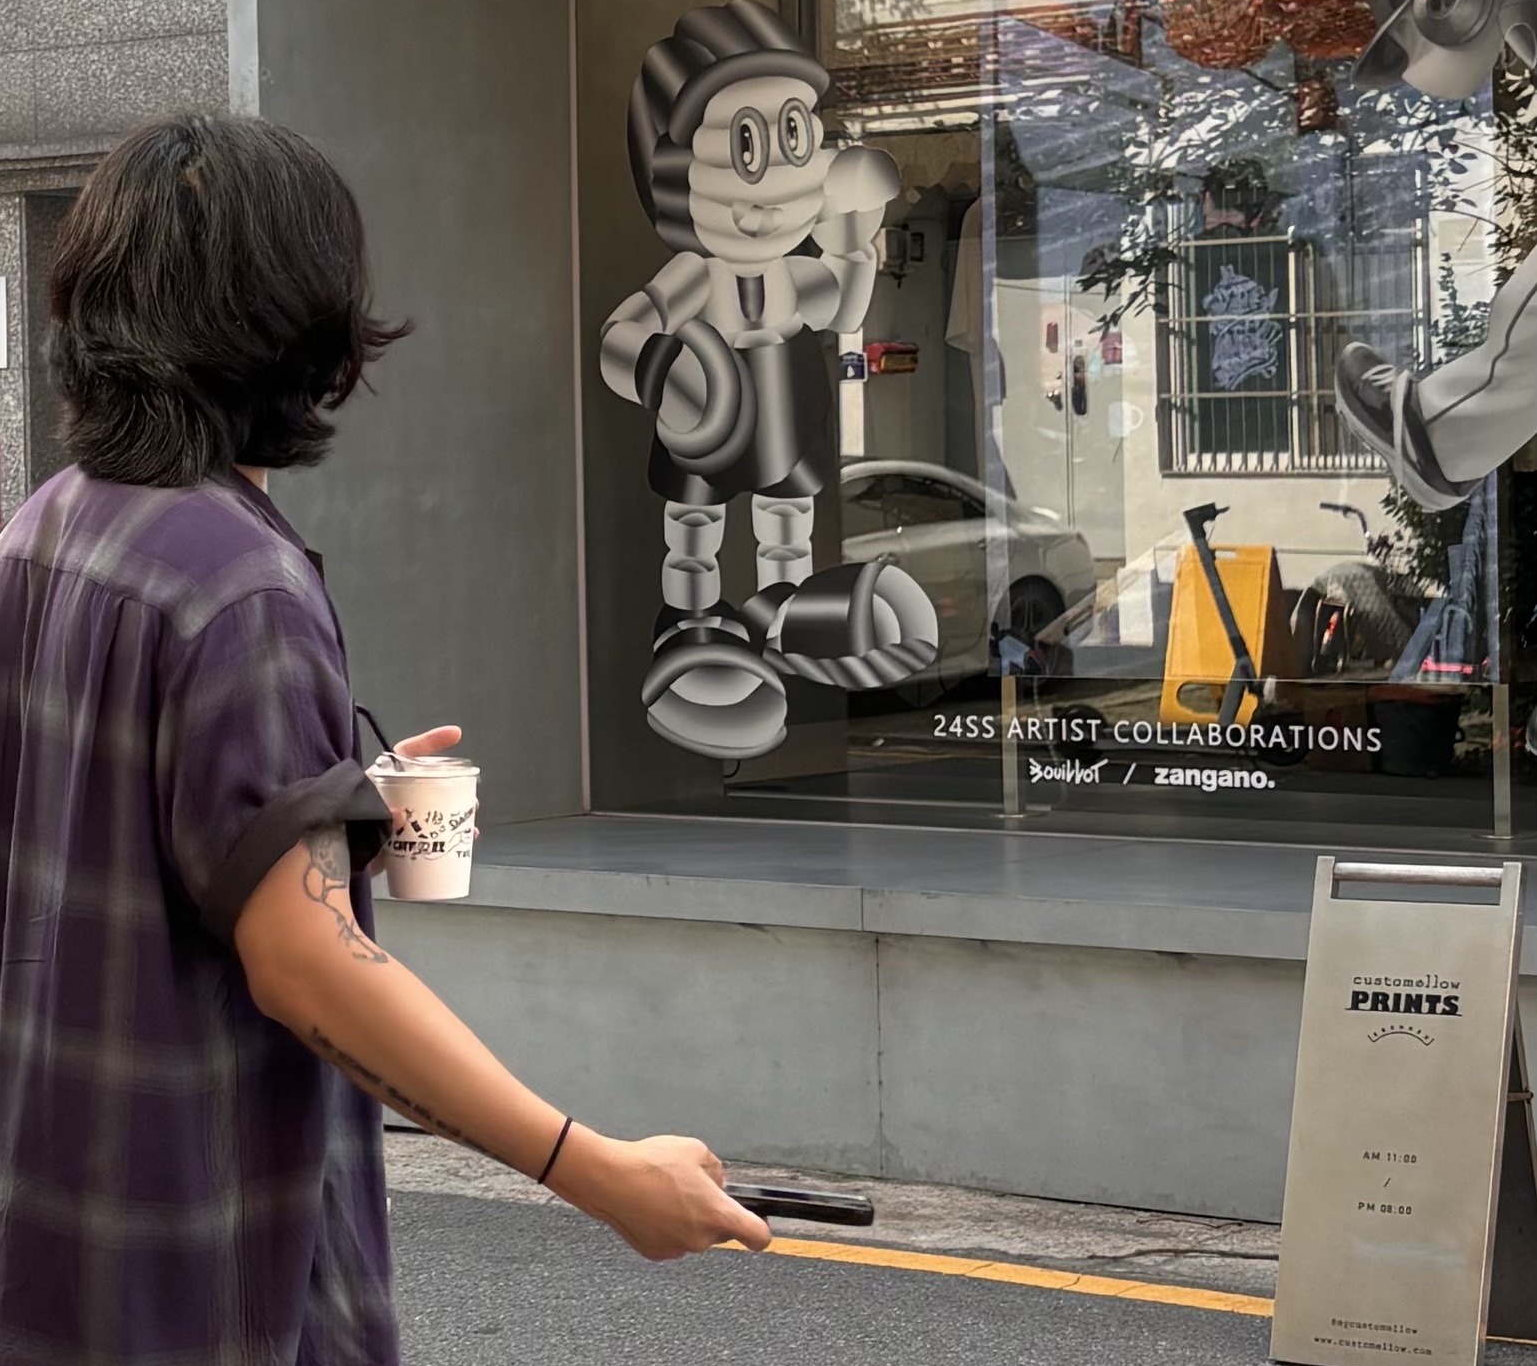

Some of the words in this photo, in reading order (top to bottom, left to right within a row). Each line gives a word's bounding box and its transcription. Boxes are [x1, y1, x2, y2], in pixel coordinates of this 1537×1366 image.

[933, 714, 995, 739] 24SS
[1006, 716, 1101, 743] ARTIST
[1113, 720, 1382, 752] COLLABORATIONS
[1154, 767, 1276, 792] zangano.
[1353, 974, 1461, 990] customellow
[1350, 990, 1461, 1016] PRINTS
[1362, 1151, 1381, 1161] AM
[1386, 1152, 1417, 1164] 11:00
[1357, 1201, 1376, 1212] PM
